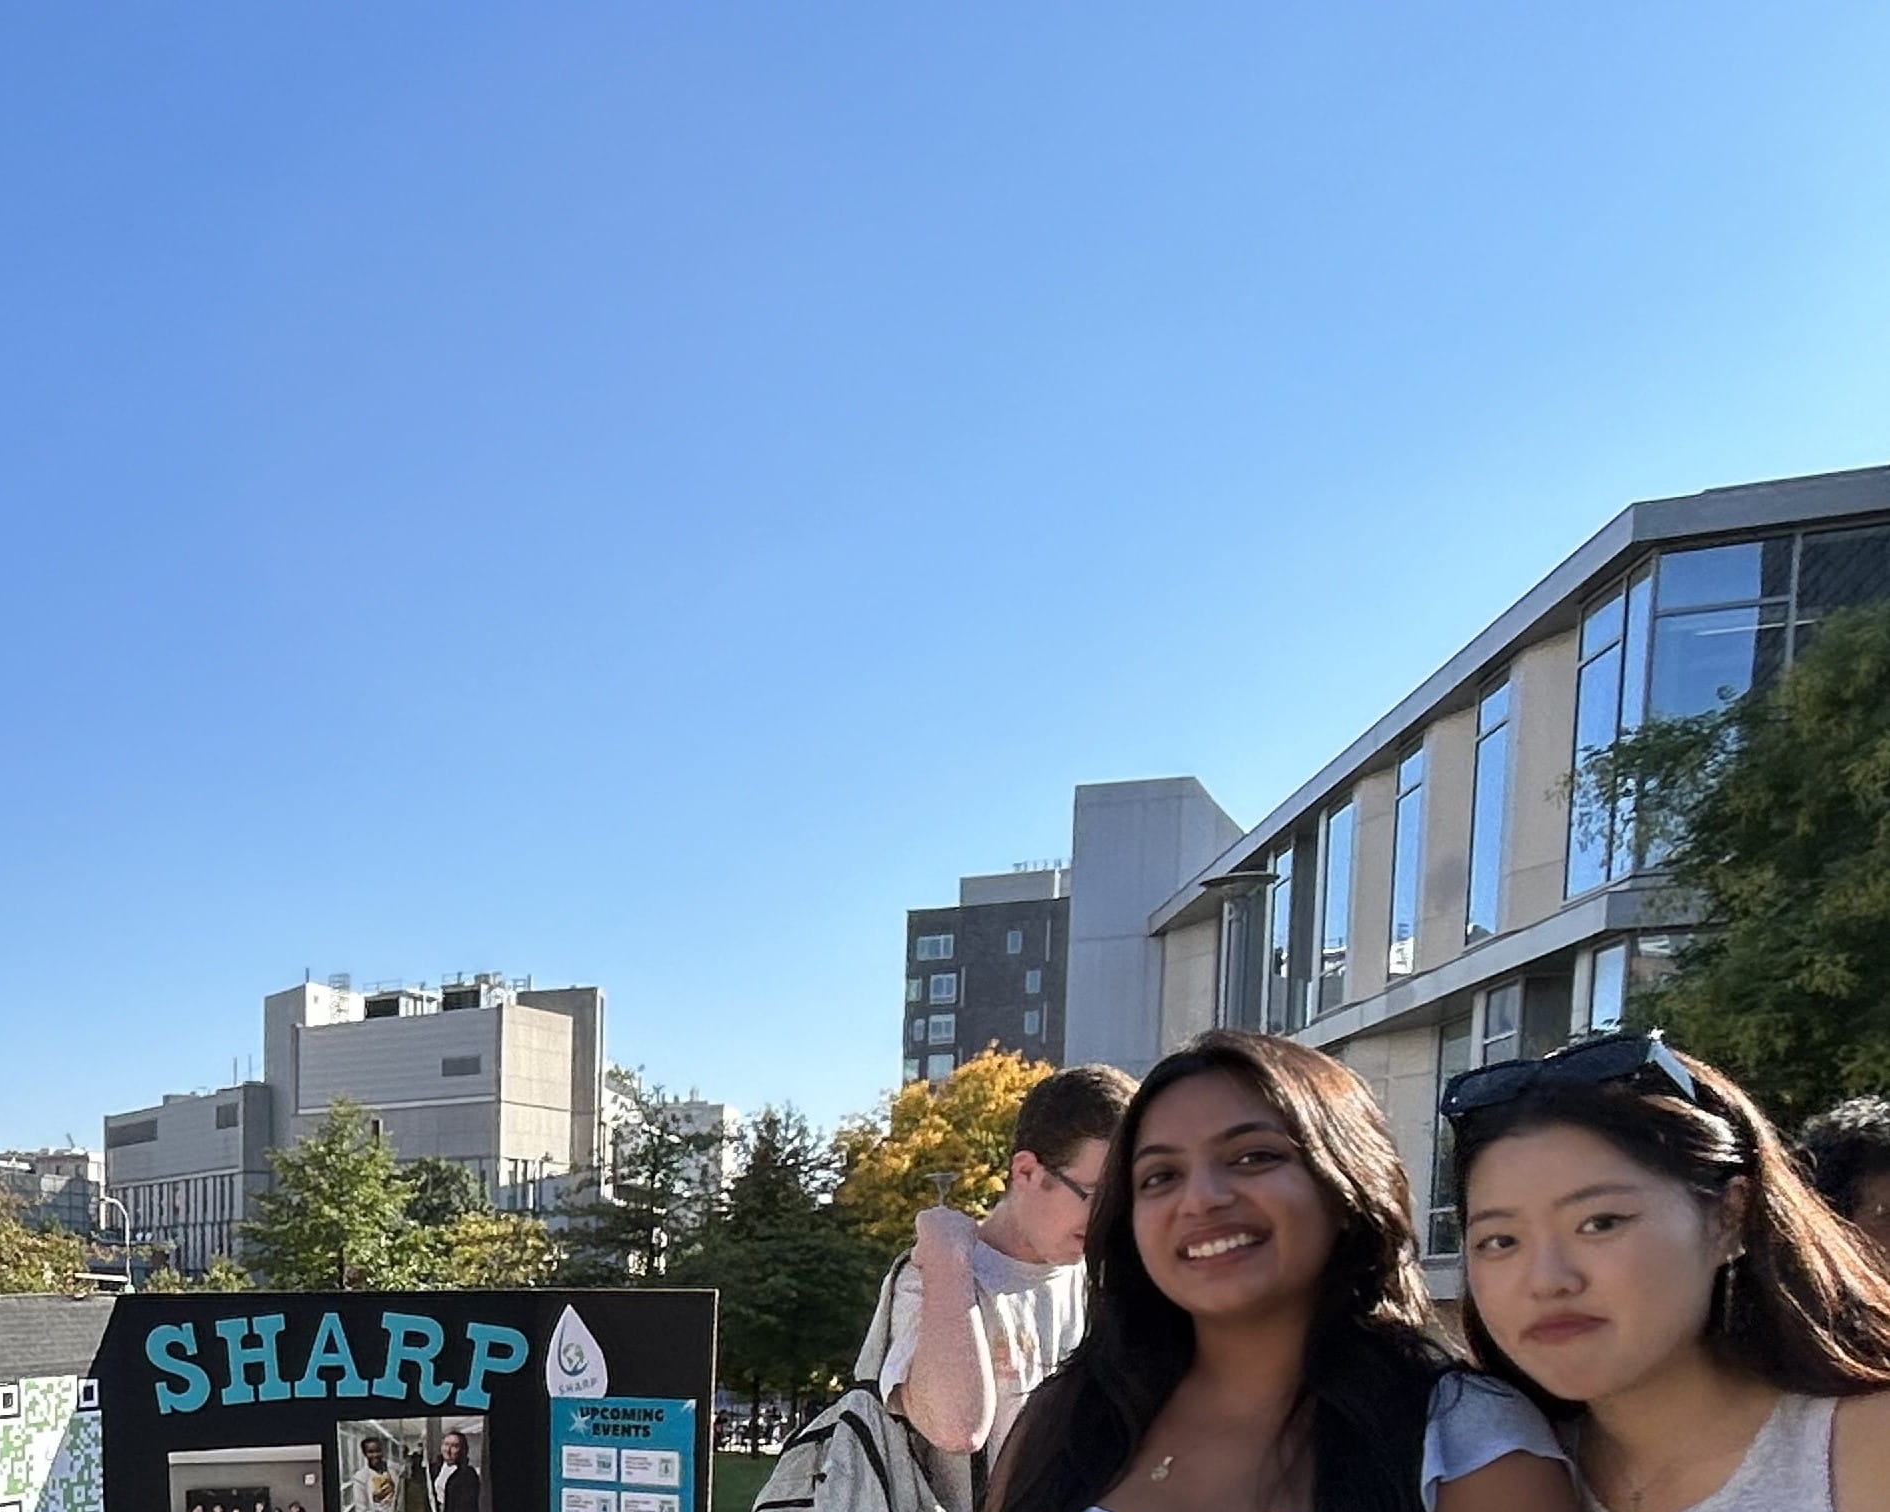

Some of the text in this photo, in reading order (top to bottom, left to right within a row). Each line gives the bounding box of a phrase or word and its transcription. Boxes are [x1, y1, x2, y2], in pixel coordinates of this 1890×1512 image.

[145, 1312, 530, 1415] SHARP
[558, 1378, 598, 1395] SHARP
[580, 1406, 665, 1422] UPCOMING
[592, 1423, 651, 1438] EVENTS
